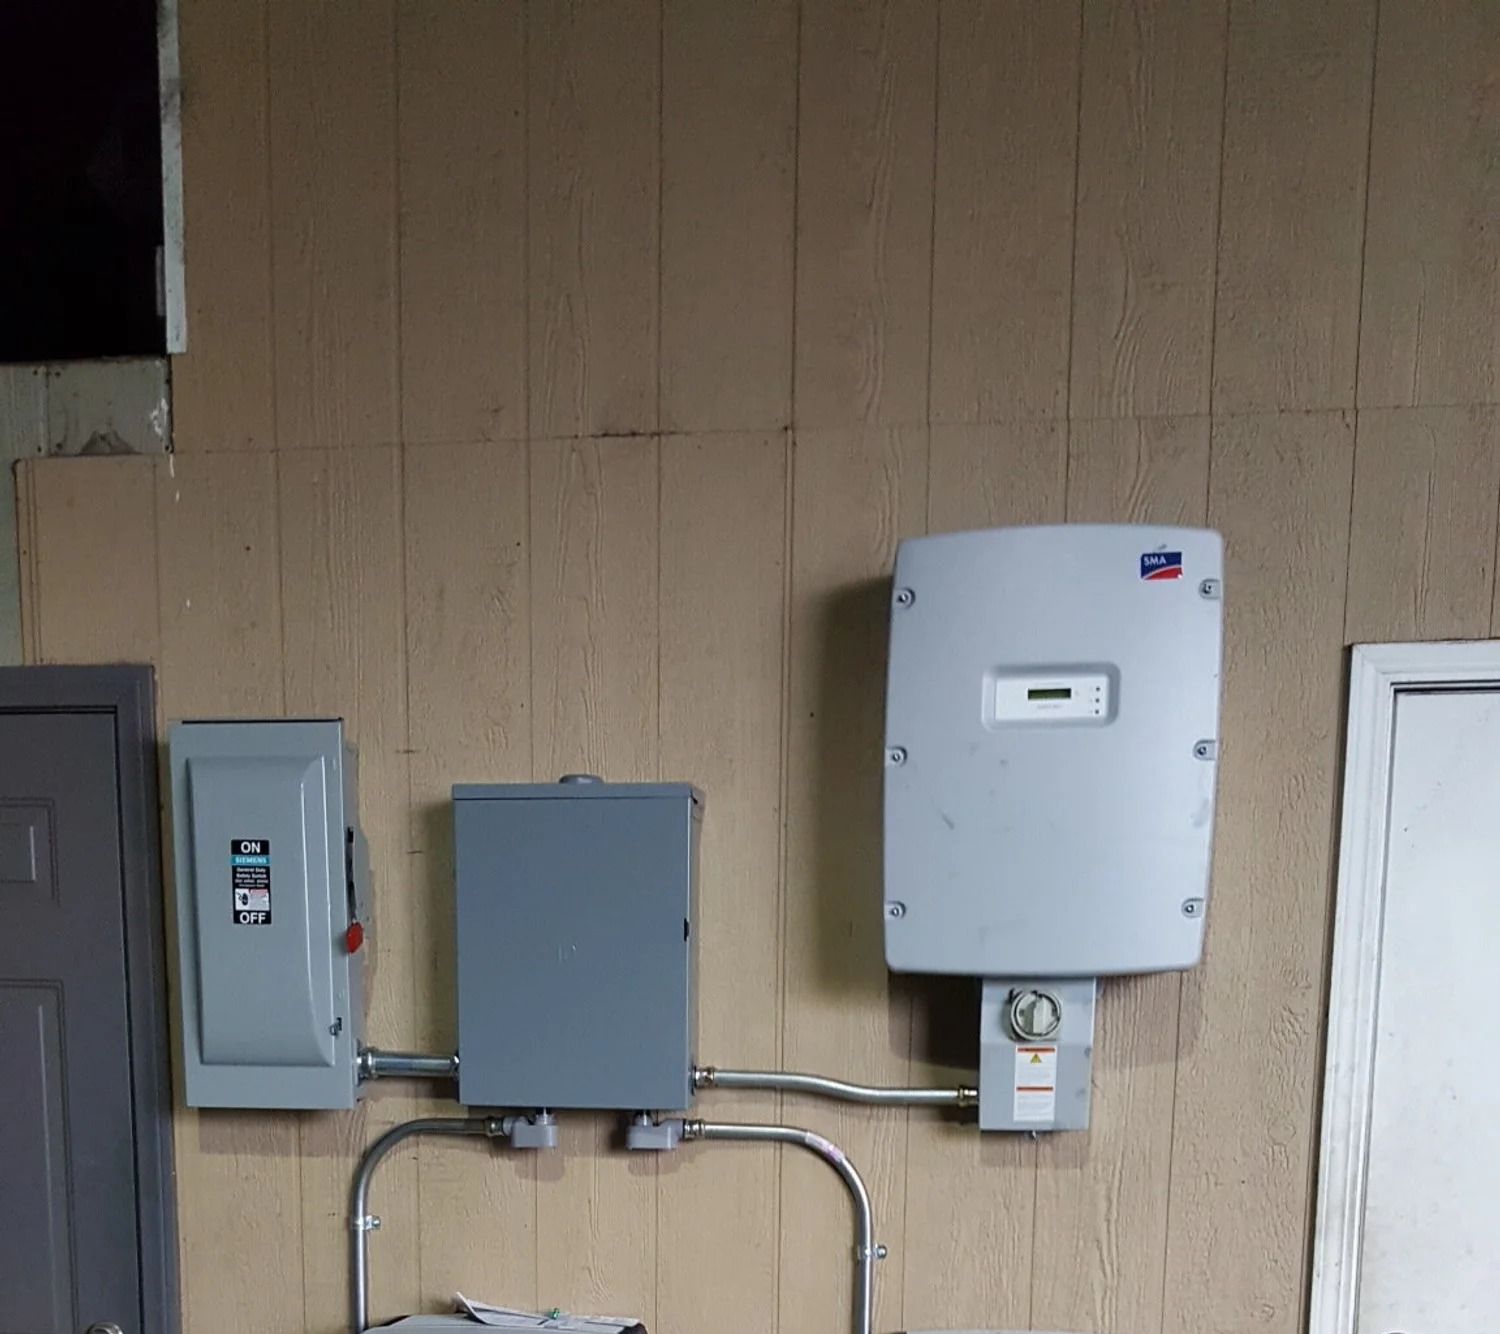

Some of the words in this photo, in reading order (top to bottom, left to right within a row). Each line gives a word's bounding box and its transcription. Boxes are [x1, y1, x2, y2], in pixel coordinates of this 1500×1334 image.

[1143, 555, 1167, 566] SMA
[240, 841, 260, 853] ON
[235, 856, 267, 865] SIEMENS
[239, 911, 267, 924] OFF
